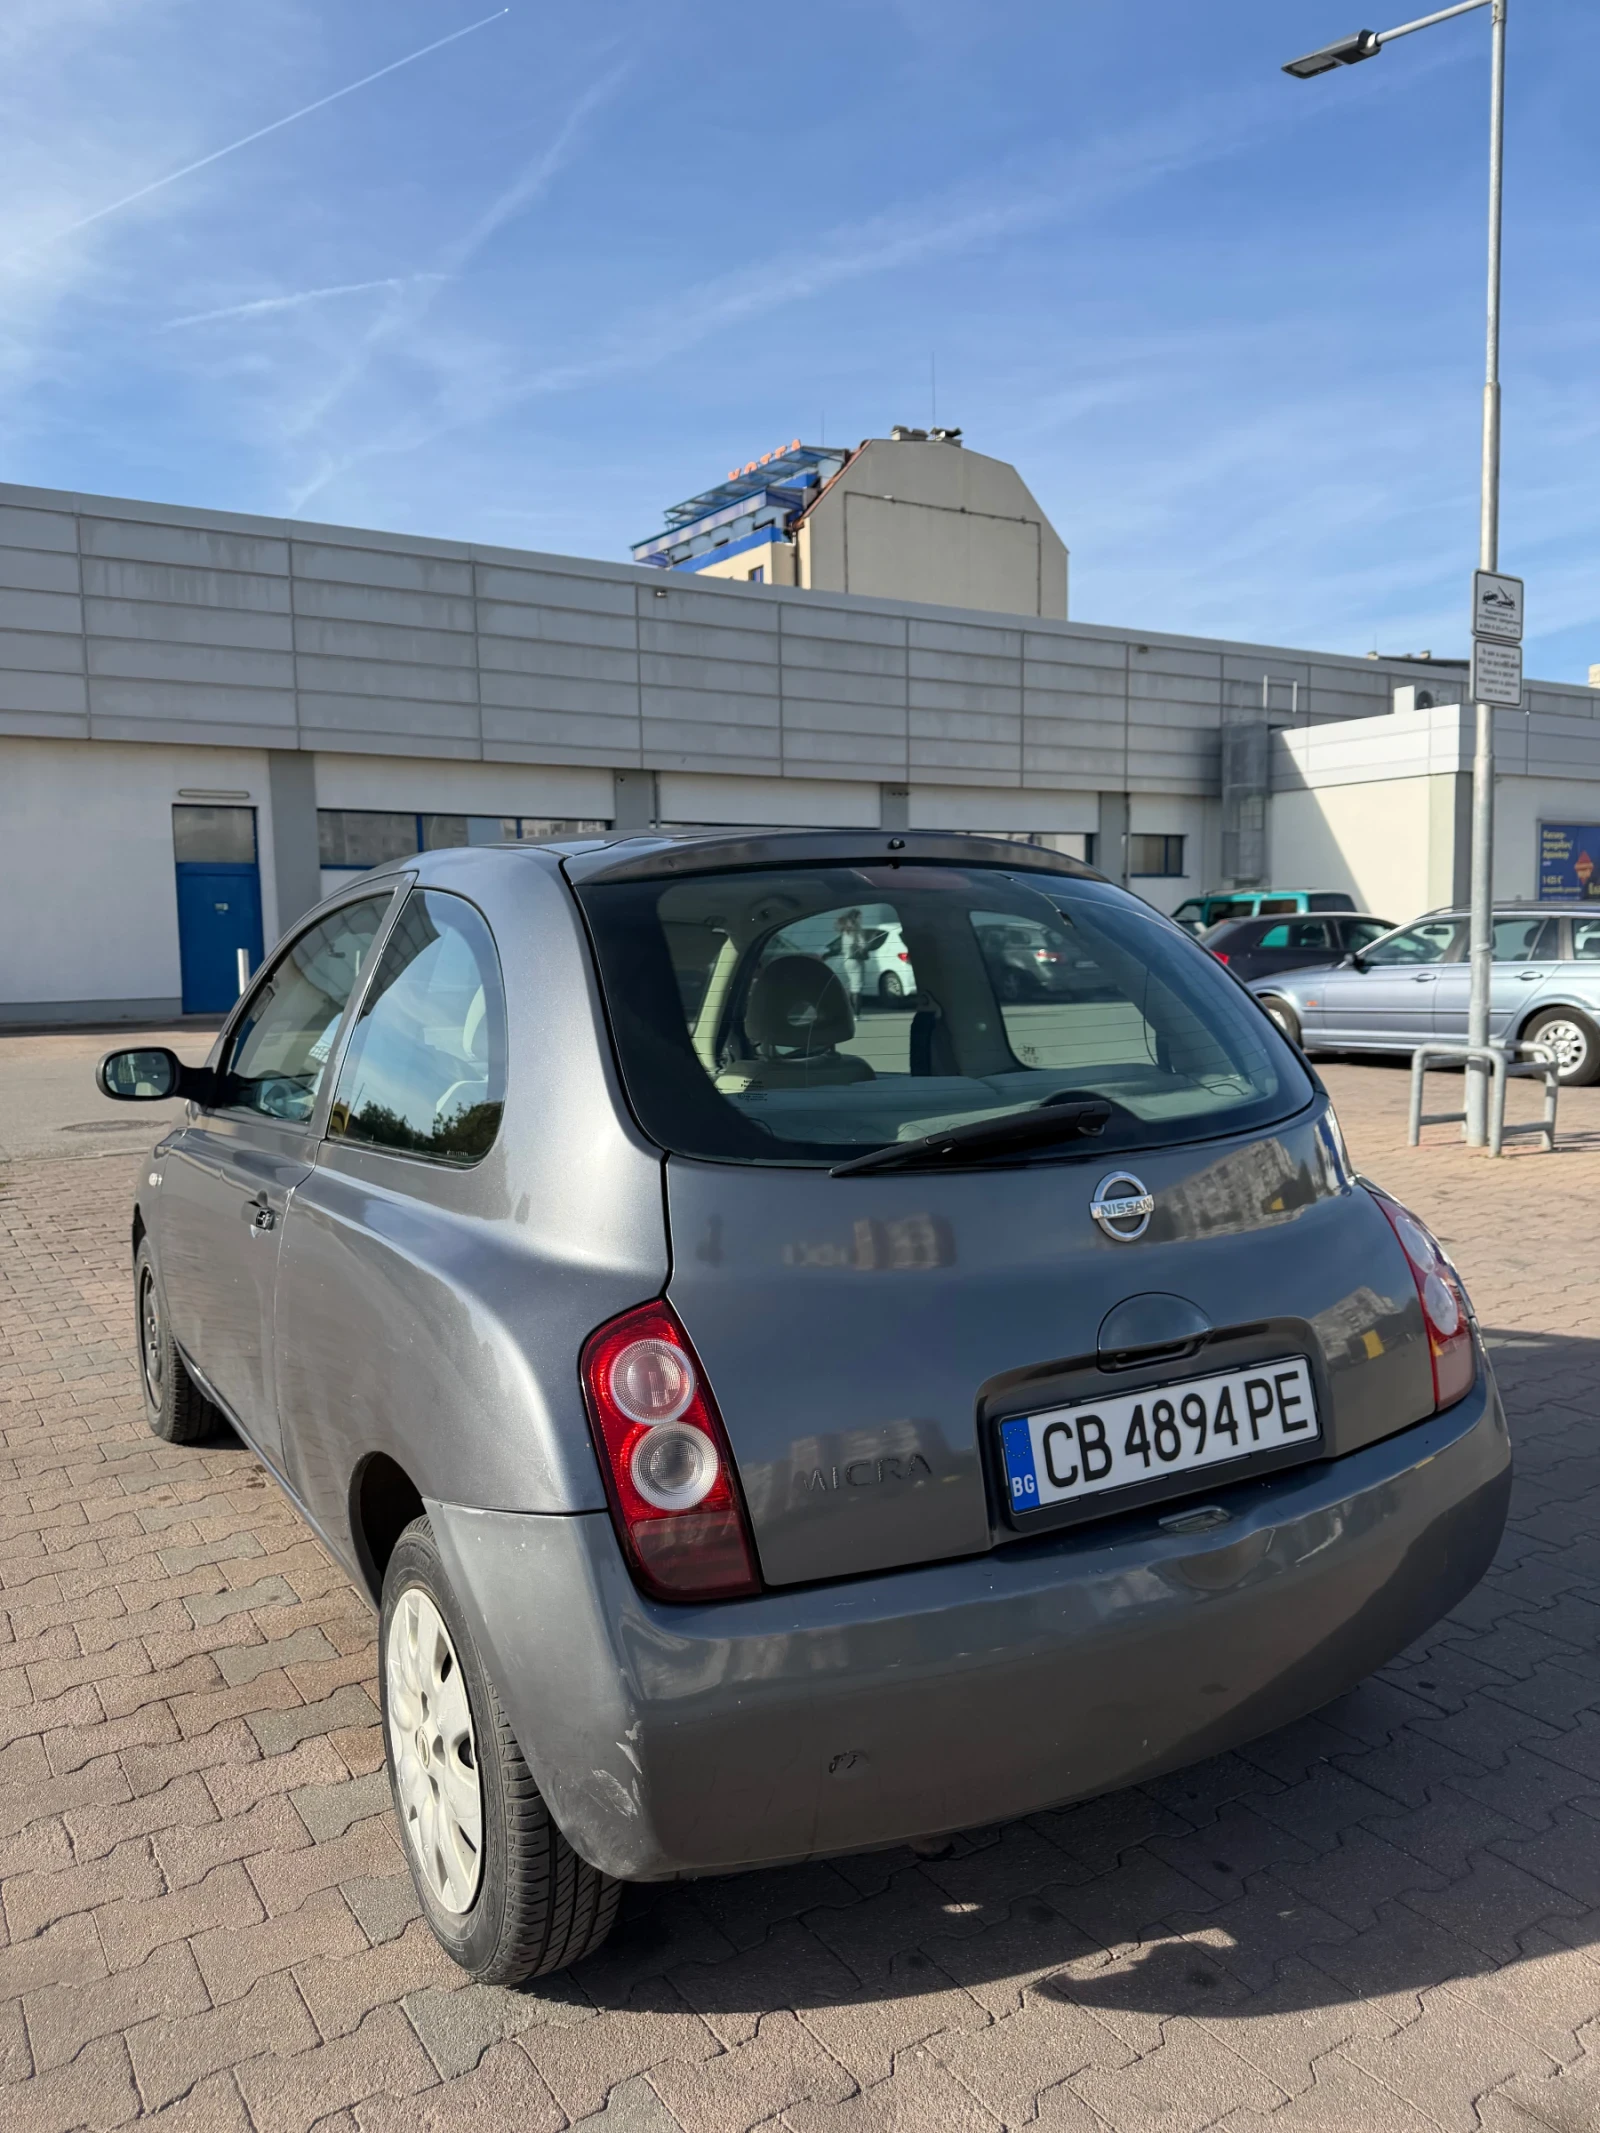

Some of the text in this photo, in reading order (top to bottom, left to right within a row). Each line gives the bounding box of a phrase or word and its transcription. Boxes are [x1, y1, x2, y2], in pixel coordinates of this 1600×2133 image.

[1100, 1198, 1152, 1215] NISSAN
[1043, 1371, 1308, 1488] CB 4894 PE
[803, 1454, 932, 1491] MICRA
[1011, 1472, 1036, 1498] BG
